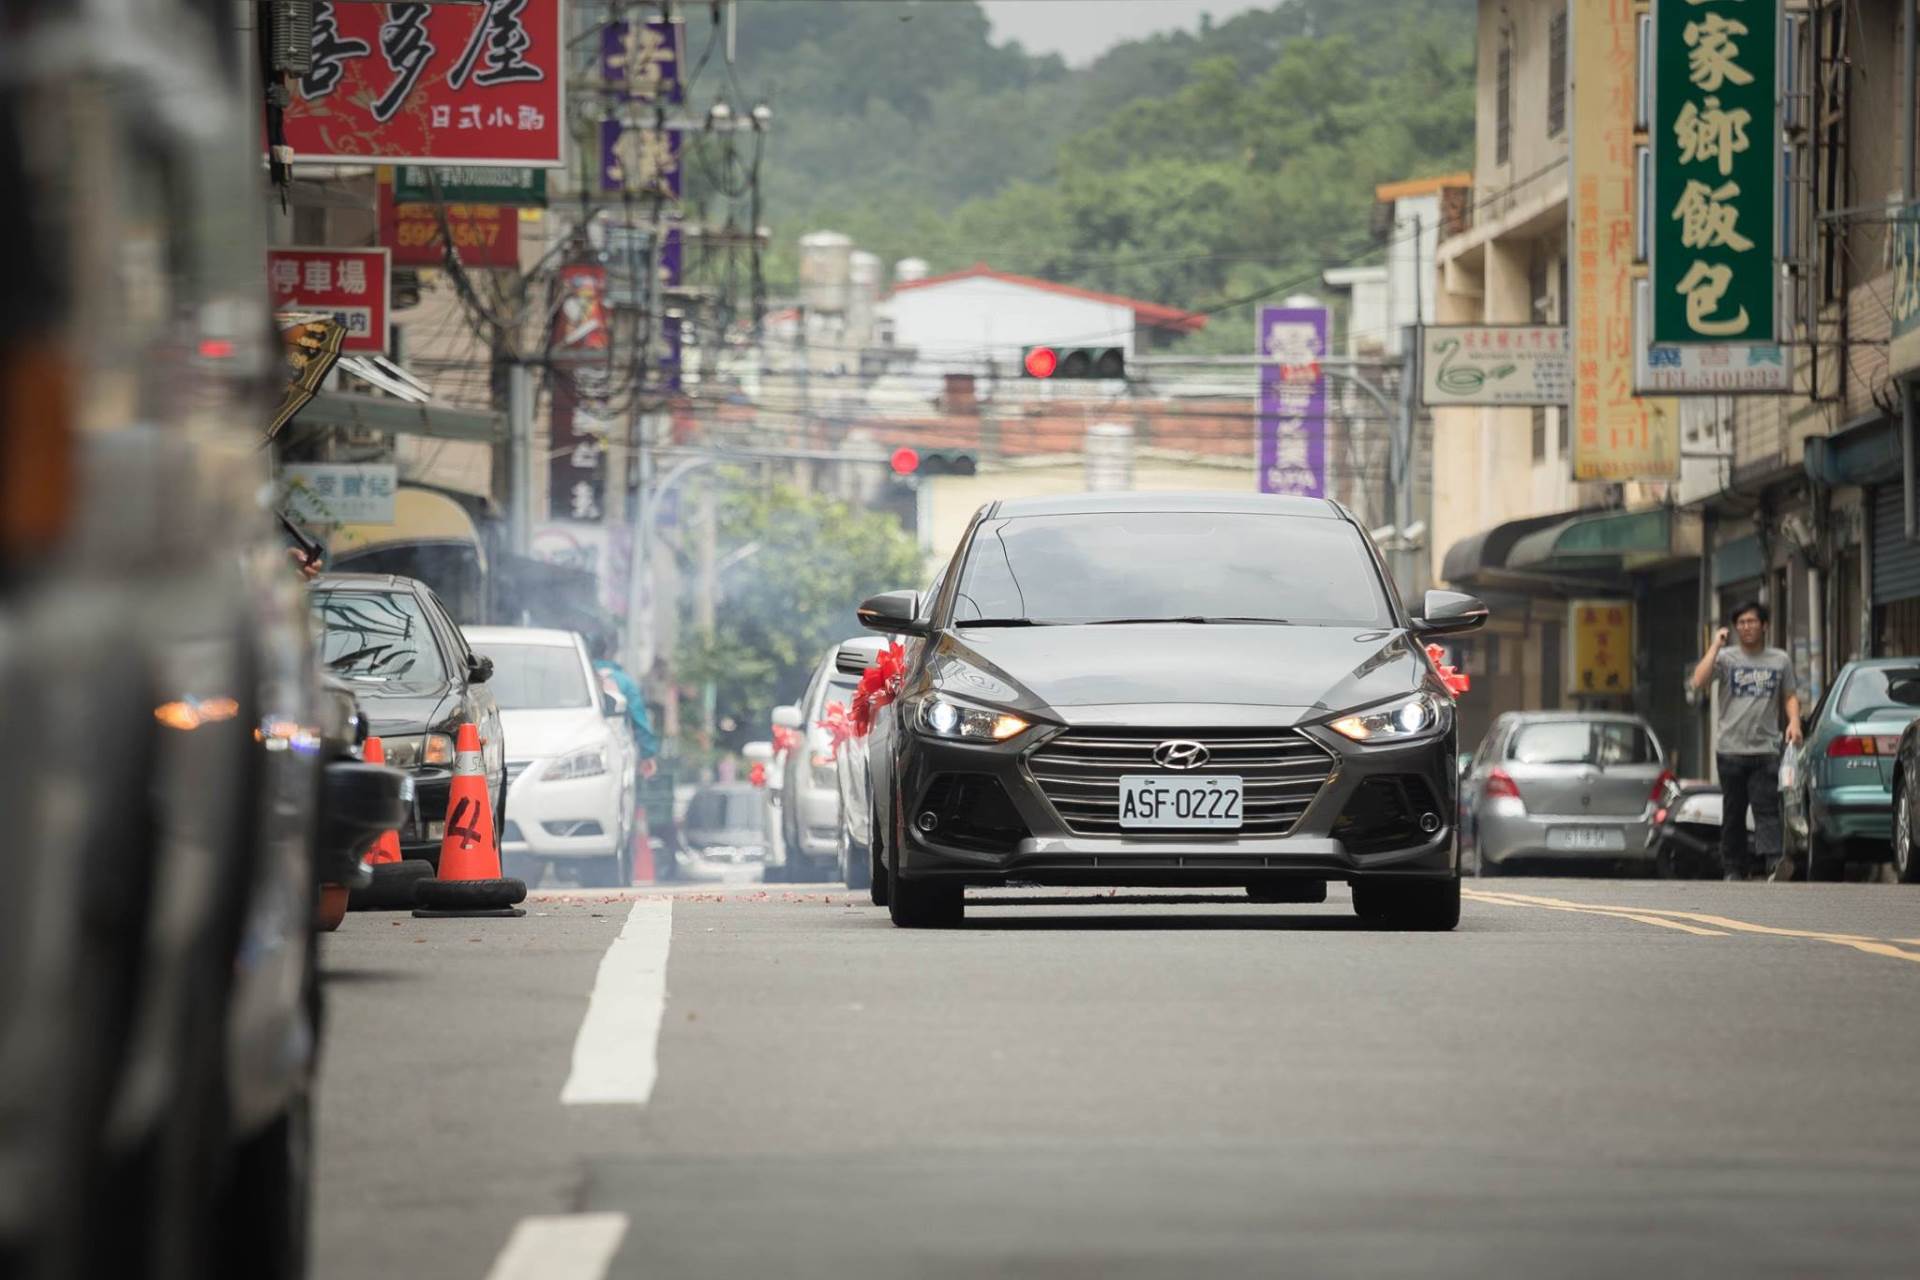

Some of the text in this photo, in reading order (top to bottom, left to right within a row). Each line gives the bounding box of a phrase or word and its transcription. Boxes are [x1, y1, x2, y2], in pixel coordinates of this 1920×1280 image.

[1671, 0, 1755, 336] 家鄉飯包
[272, 260, 367, 294] 停車場
[447, 796, 482, 850] 4
